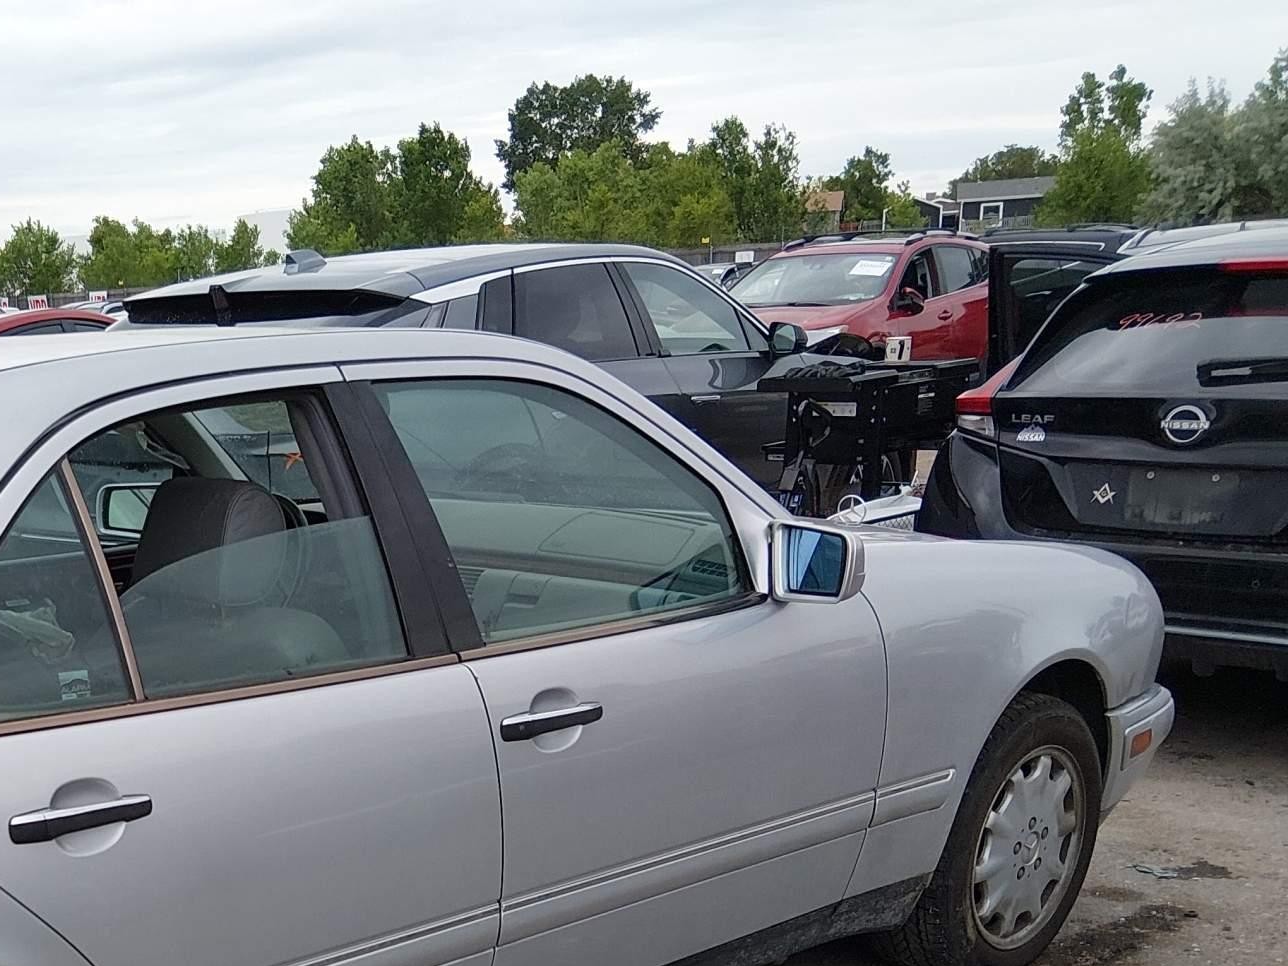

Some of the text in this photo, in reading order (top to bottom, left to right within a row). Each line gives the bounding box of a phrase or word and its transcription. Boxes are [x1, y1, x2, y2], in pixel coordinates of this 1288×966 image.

[1011, 413, 1056, 424] LEAF
[1160, 419, 1210, 430] NISSAN
[1016, 431, 1046, 442] NISSAN
